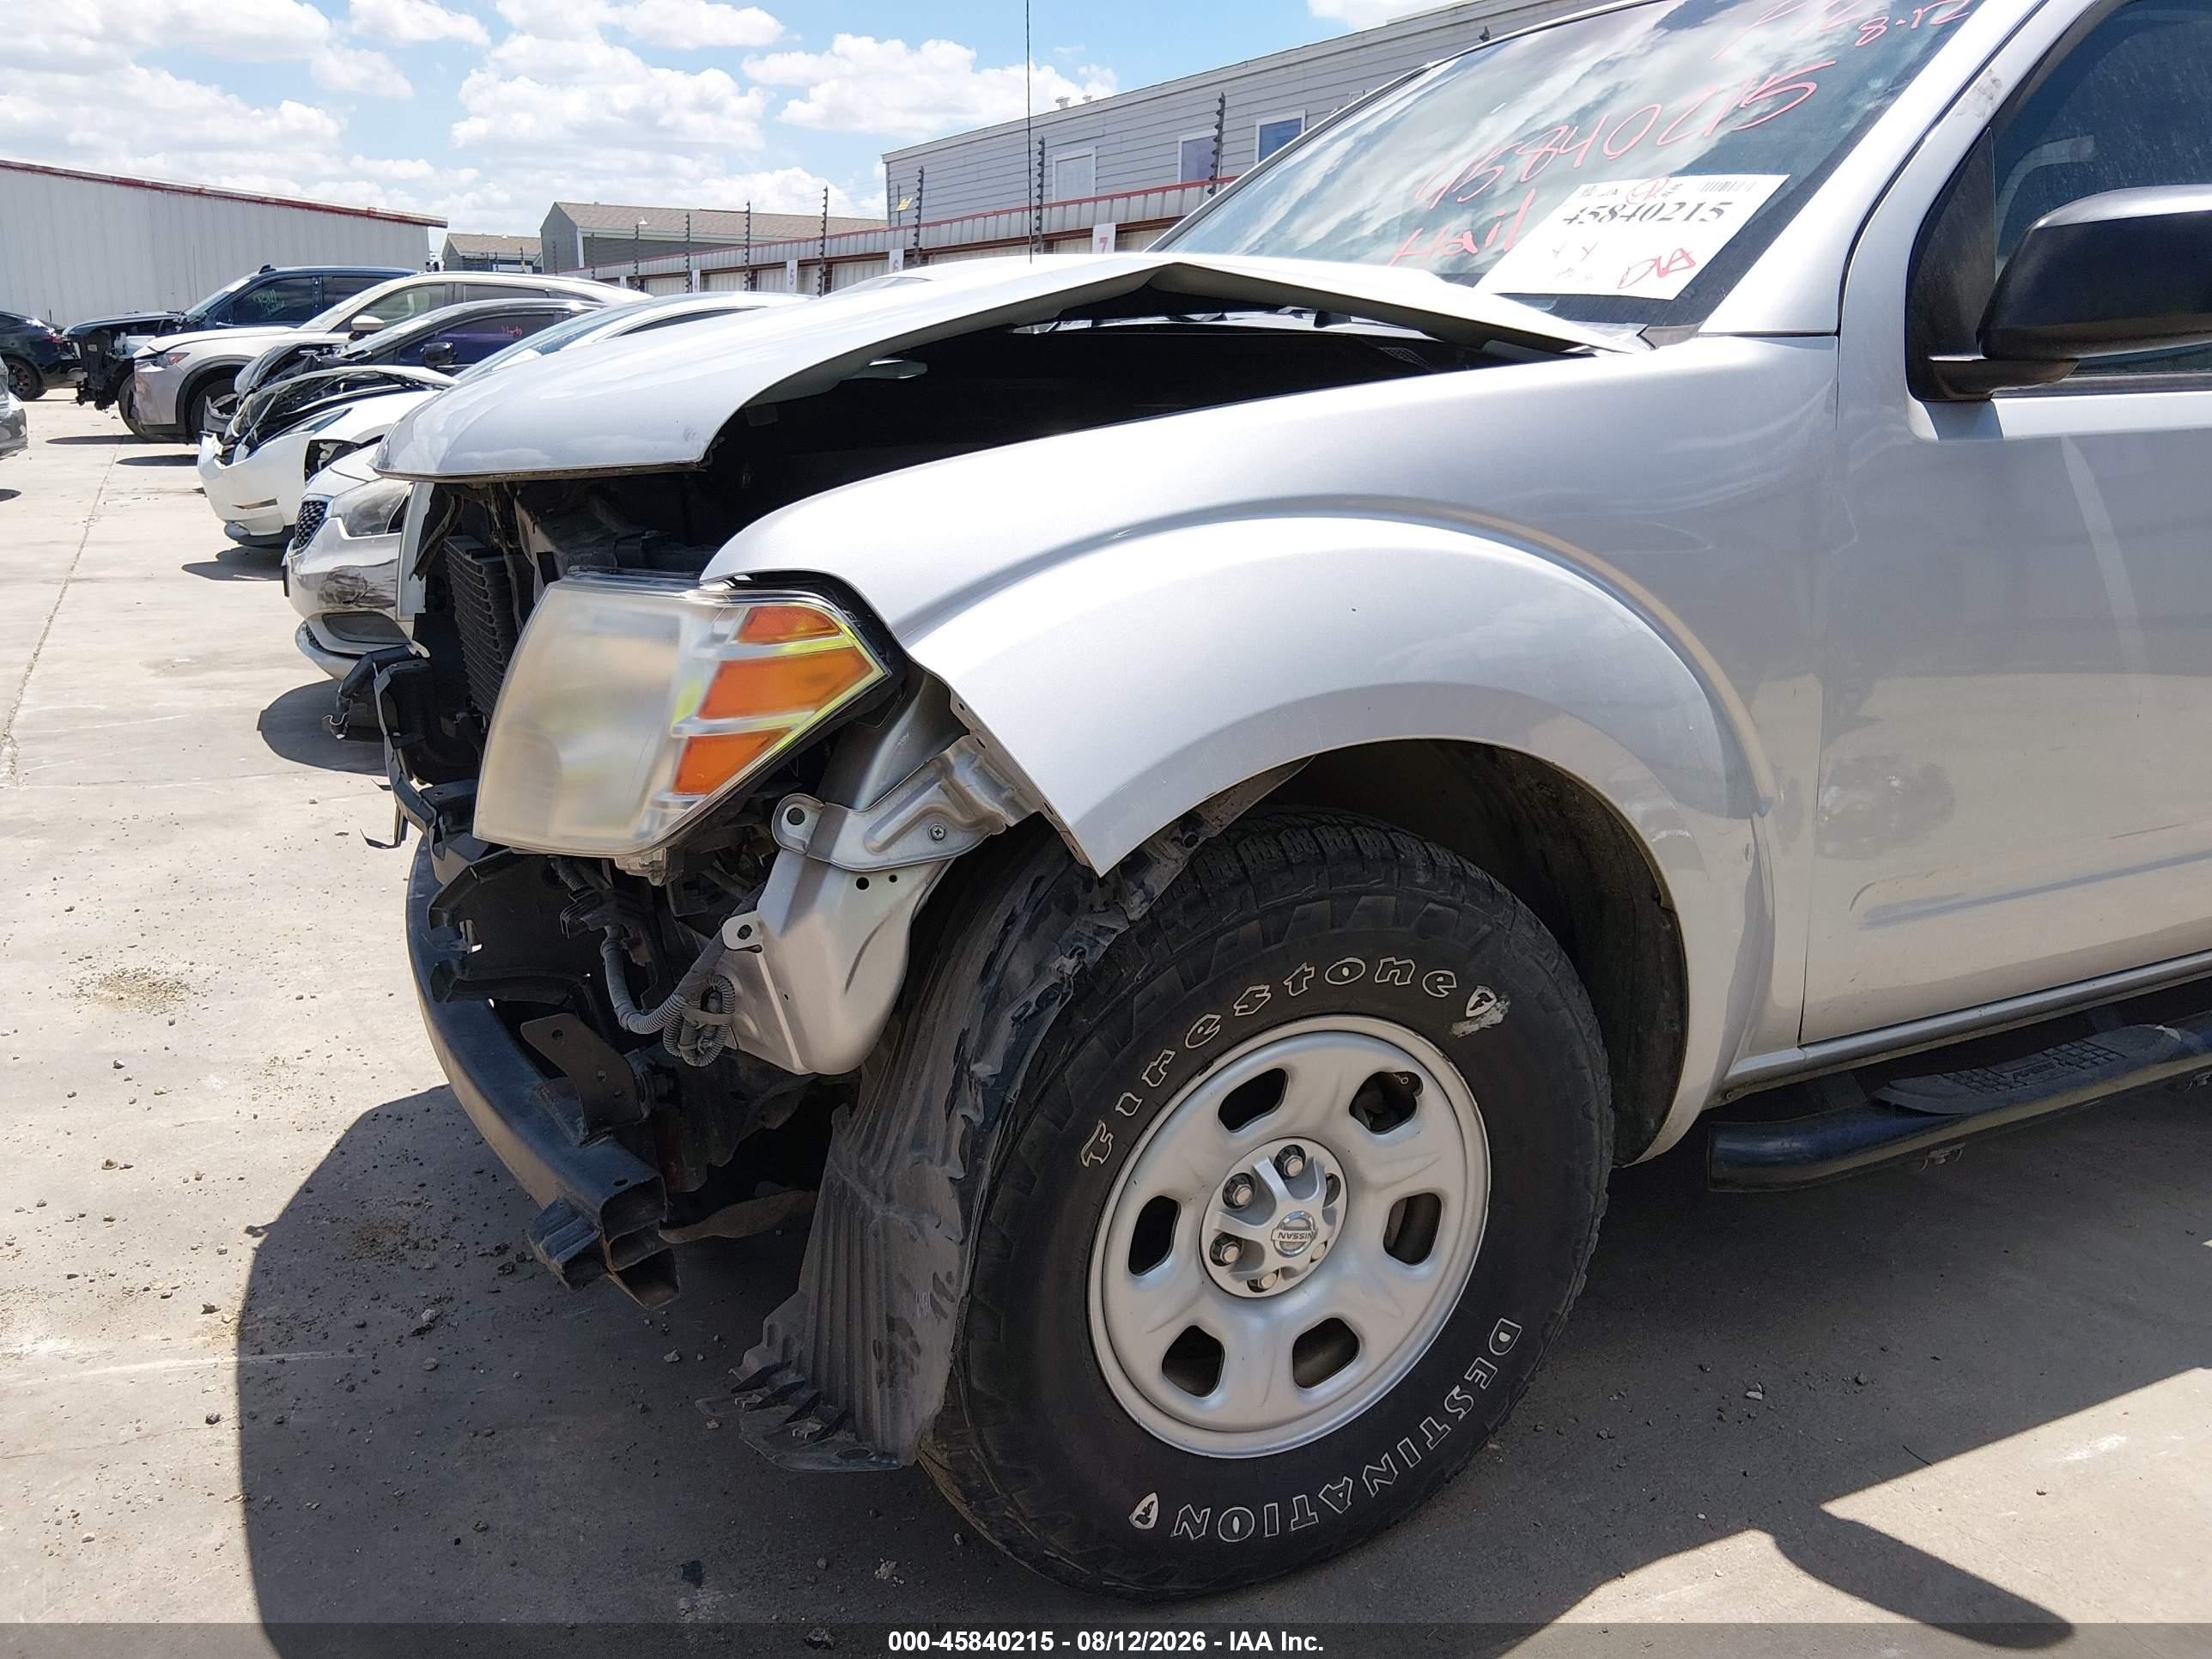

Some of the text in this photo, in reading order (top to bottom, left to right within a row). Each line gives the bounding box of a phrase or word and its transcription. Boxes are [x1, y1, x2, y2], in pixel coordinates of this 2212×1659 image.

[1389, 188, 1537, 266] Hail
[1563, 201, 1734, 225] 45840215
[1080, 957, 1457, 1168] Firestone
[1277, 1231, 1315, 1240] NISSAN
[1170, 1317, 1522, 1543] DESTINATION
